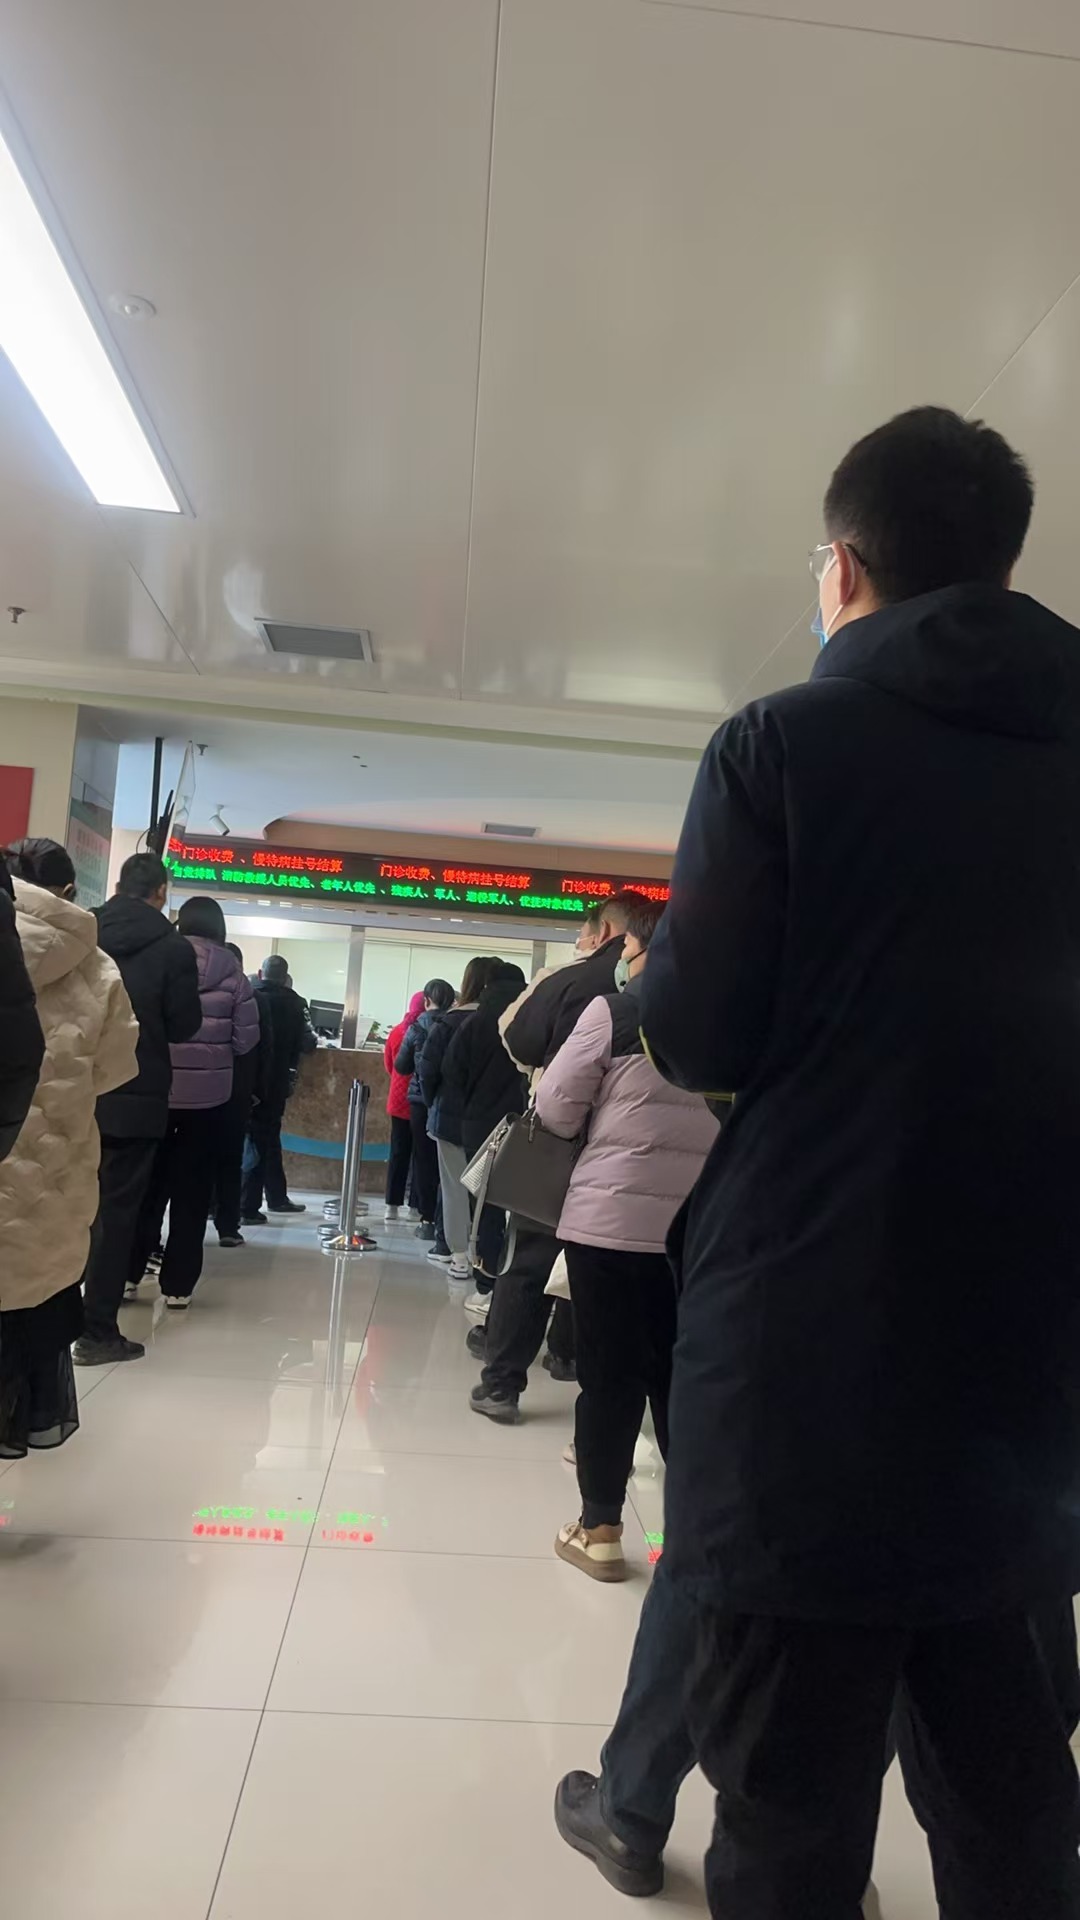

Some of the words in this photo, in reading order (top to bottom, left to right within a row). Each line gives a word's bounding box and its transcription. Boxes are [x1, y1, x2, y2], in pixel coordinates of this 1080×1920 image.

[380, 863, 531, 889] 门诊收费、慢特病挂号结算
